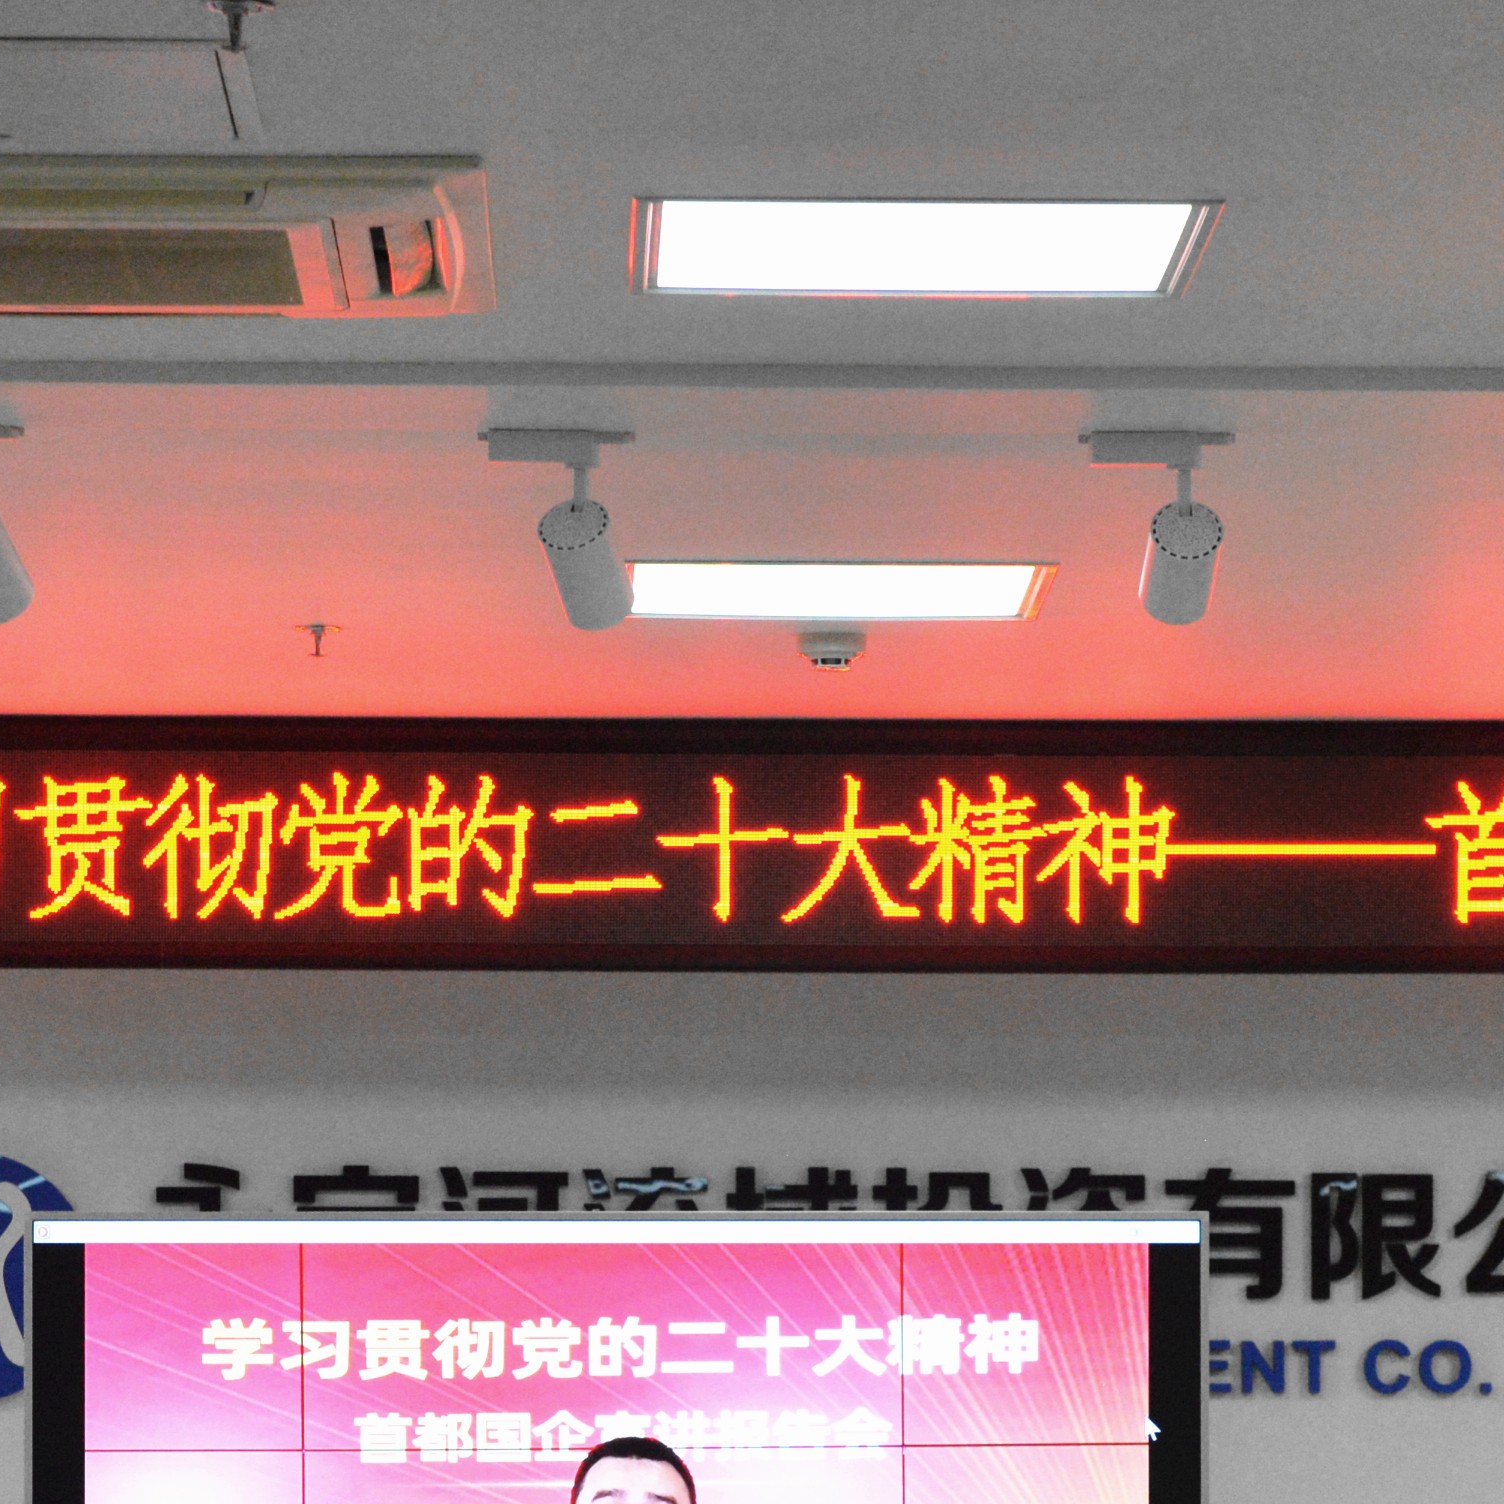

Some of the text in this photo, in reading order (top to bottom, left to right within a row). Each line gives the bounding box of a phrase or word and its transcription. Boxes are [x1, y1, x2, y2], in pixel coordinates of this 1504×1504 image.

[200, 1313, 1041, 1381] 学习贯彻党的二十大精神
